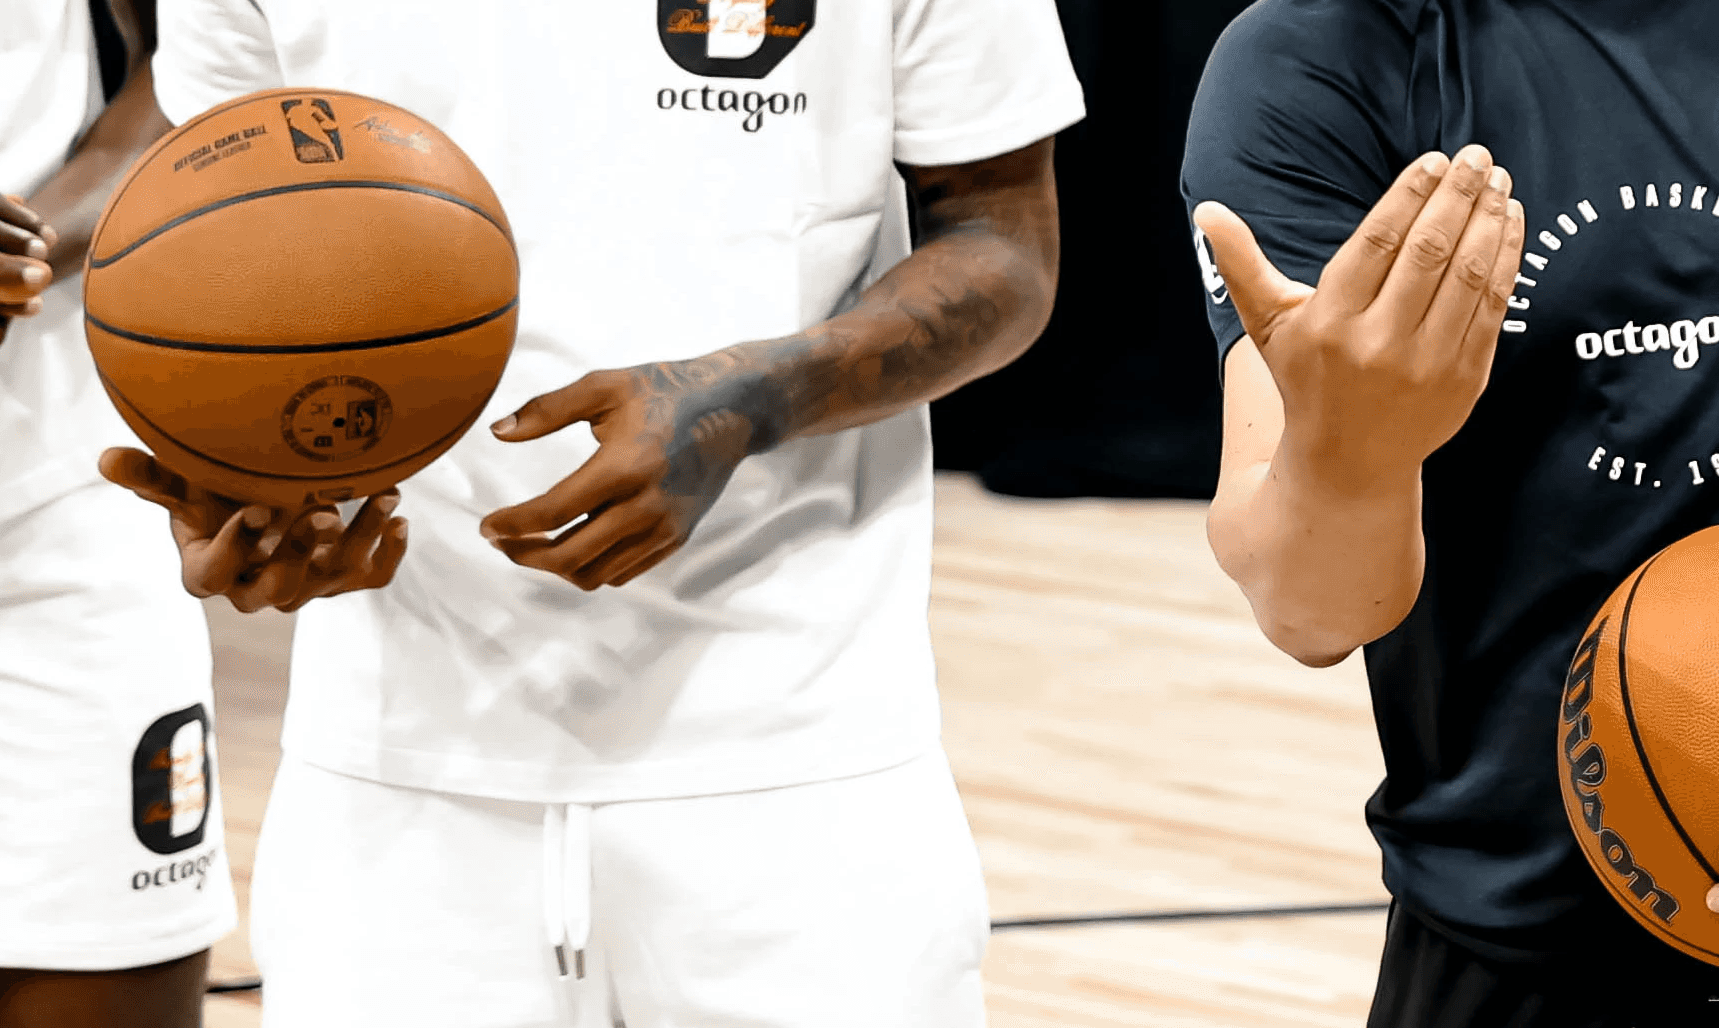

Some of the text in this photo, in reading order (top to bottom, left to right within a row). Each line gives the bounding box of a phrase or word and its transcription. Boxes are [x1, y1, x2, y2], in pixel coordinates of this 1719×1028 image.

[657, 84, 807, 133] octagon
[1502, 199, 1598, 333] OCTAGON
[1588, 446, 1662, 488] EST.
[1564, 615, 1680, 926] Wilson
